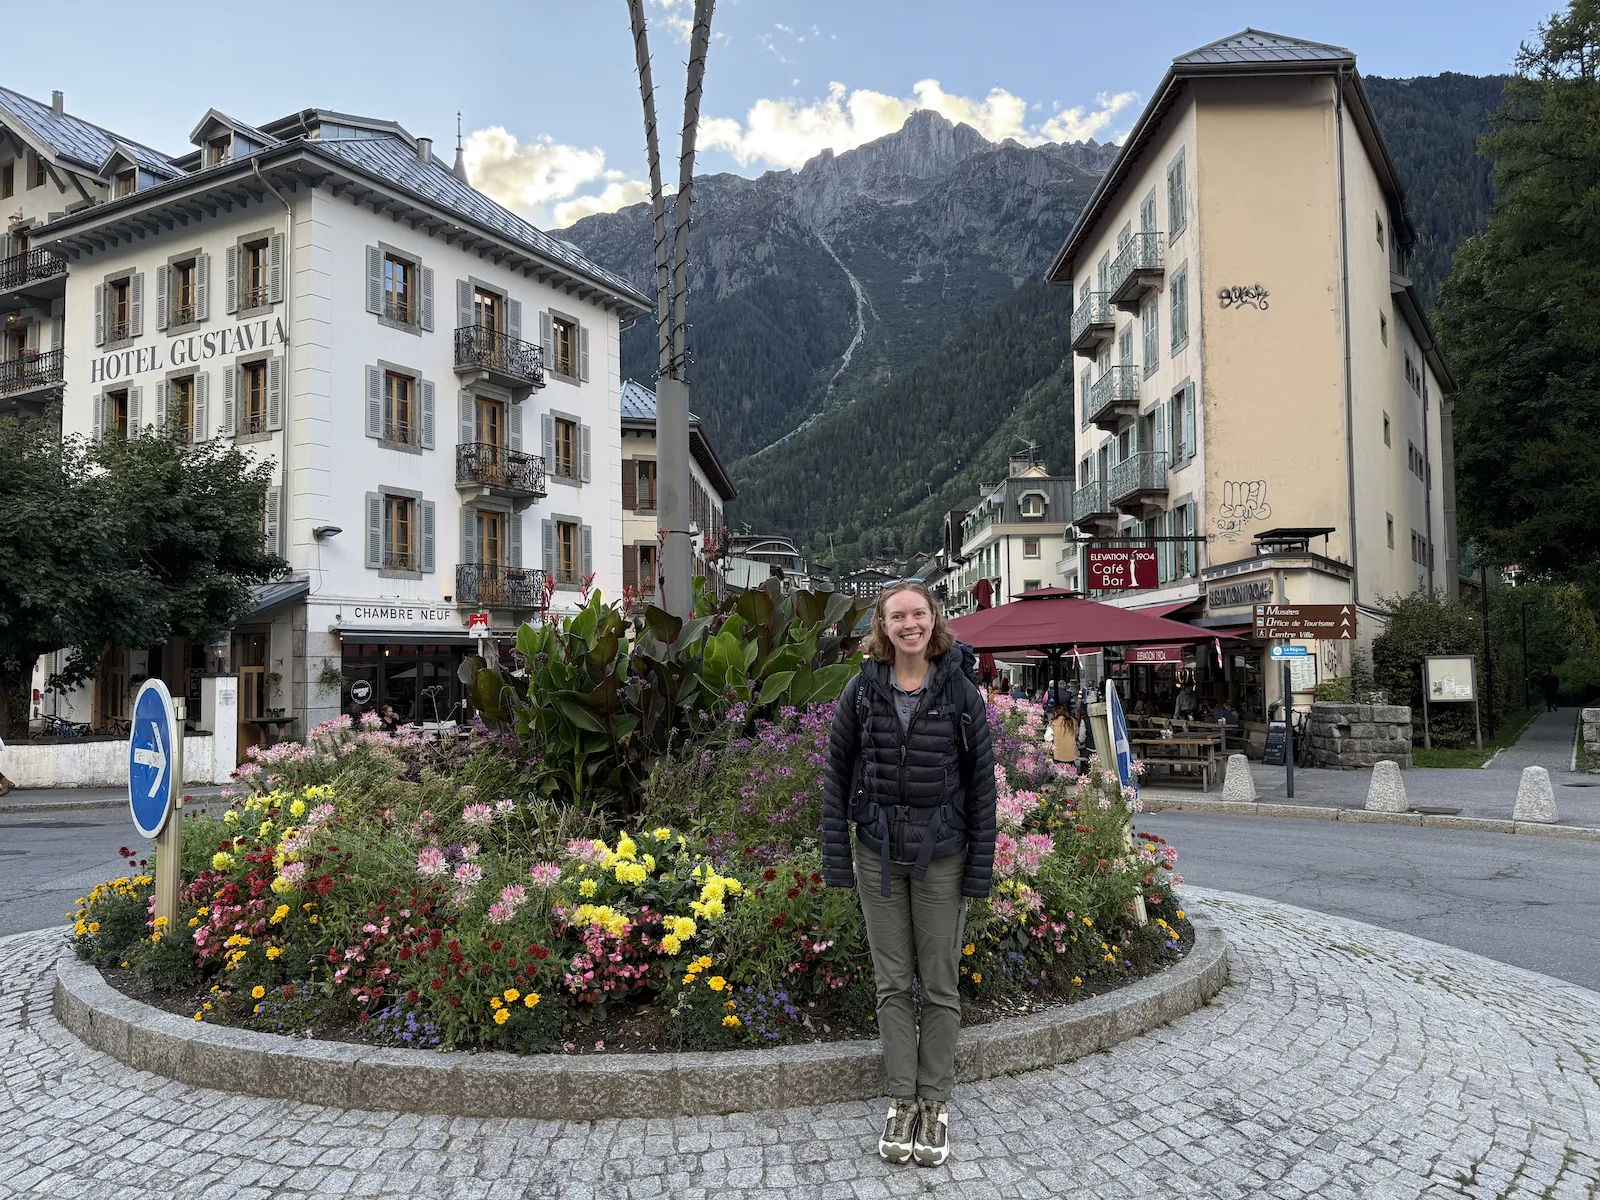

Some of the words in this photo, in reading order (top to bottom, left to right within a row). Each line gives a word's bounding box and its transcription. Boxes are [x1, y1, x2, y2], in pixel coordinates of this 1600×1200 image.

[90, 345, 163, 384] HOTEL
[170, 317, 286, 366] GUSTAVIA
[1090, 553, 1129, 561] ELEVATION
[1136, 552, 1155, 561] 1904
[1092, 562, 1124, 574] Café
[1102, 575, 1124, 586] Bar
[354, 607, 413, 620] CHAMBRE
[420, 610, 451, 621] NEUF
[1266, 606, 1300, 616] Musées
[1266, 617, 1290, 627] Office
[1303, 619, 1335, 627] Tourisme
[1269, 628, 1297, 638] Centre
